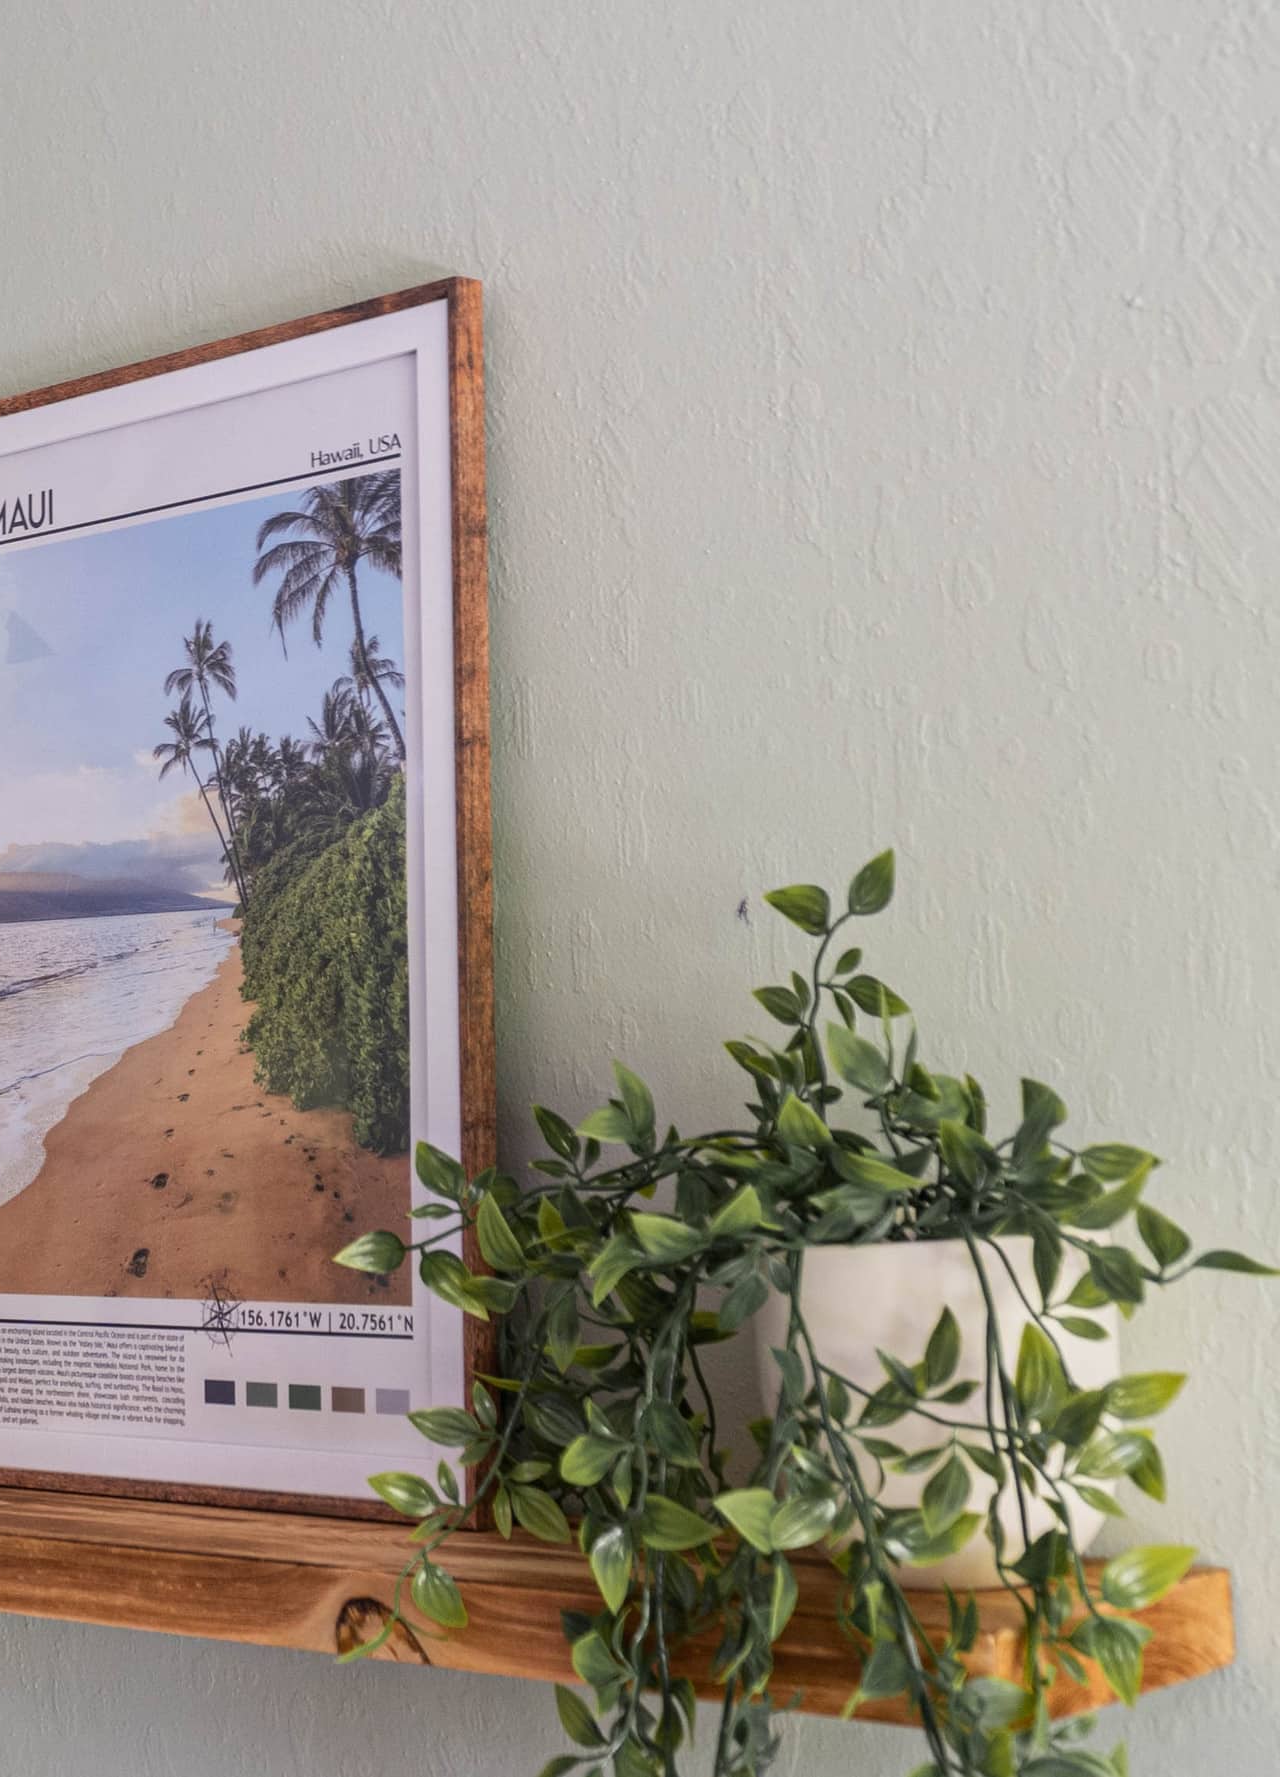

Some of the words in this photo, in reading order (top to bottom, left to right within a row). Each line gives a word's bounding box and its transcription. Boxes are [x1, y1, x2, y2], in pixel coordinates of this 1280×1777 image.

[311, 442, 364, 468] Hawaii,
[369, 433, 401, 455] USA
[241, 1310, 321, 1328] 156.1761°W
[339, 1313, 413, 1331] 20.7561°N
